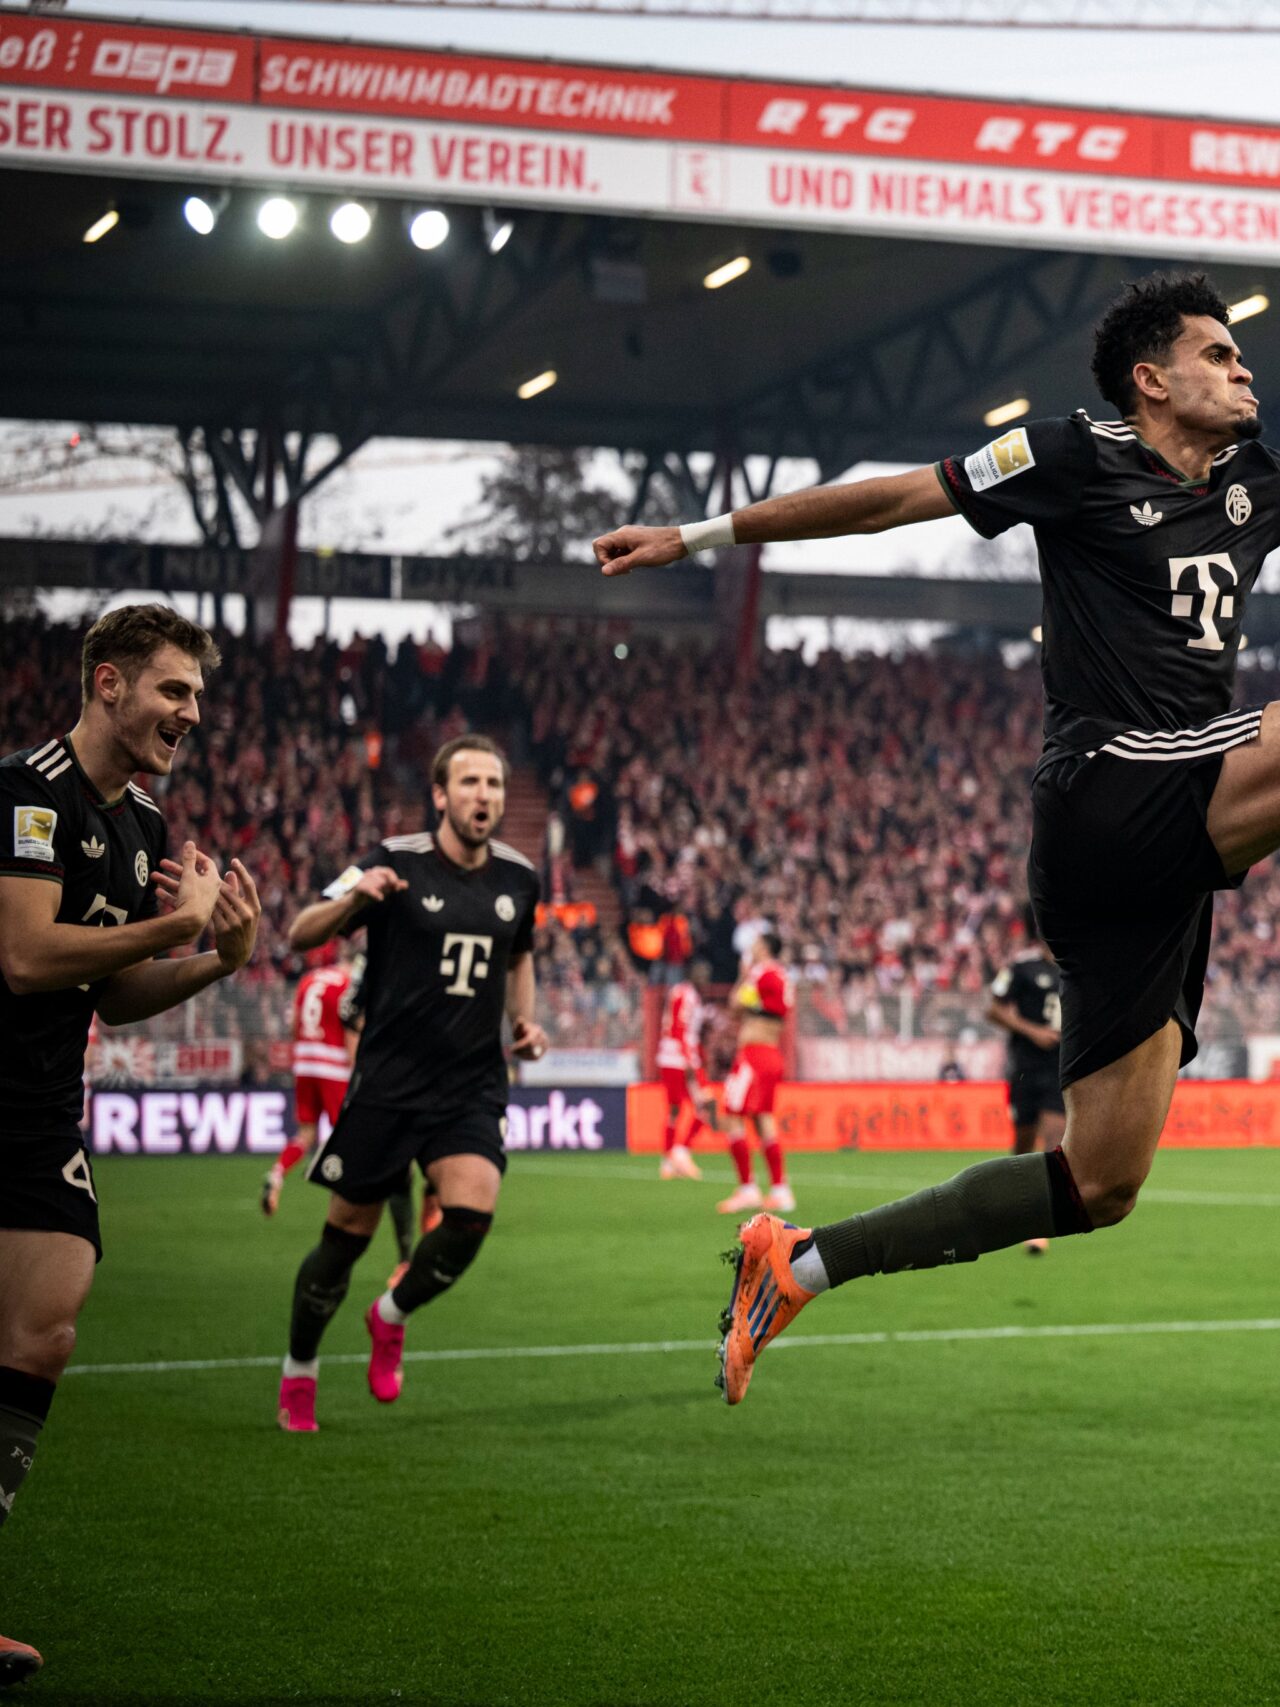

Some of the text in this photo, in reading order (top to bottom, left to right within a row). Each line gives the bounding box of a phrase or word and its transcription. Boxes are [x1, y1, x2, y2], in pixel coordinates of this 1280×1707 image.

[91, 39, 238, 94] ospa
[259, 54, 677, 126] SCHWIMMBADTECHNIK
[86, 105, 243, 164] STOLZ.
[269, 120, 415, 178] UNSER
[431, 134, 599, 193] VEREIN.
[757, 98, 916, 143] RTC
[975, 117, 1128, 161] RTC
[767, 163, 855, 210] UND
[869, 171, 1043, 225] NIEMALS
[94, 1092, 287, 1155] REWE
